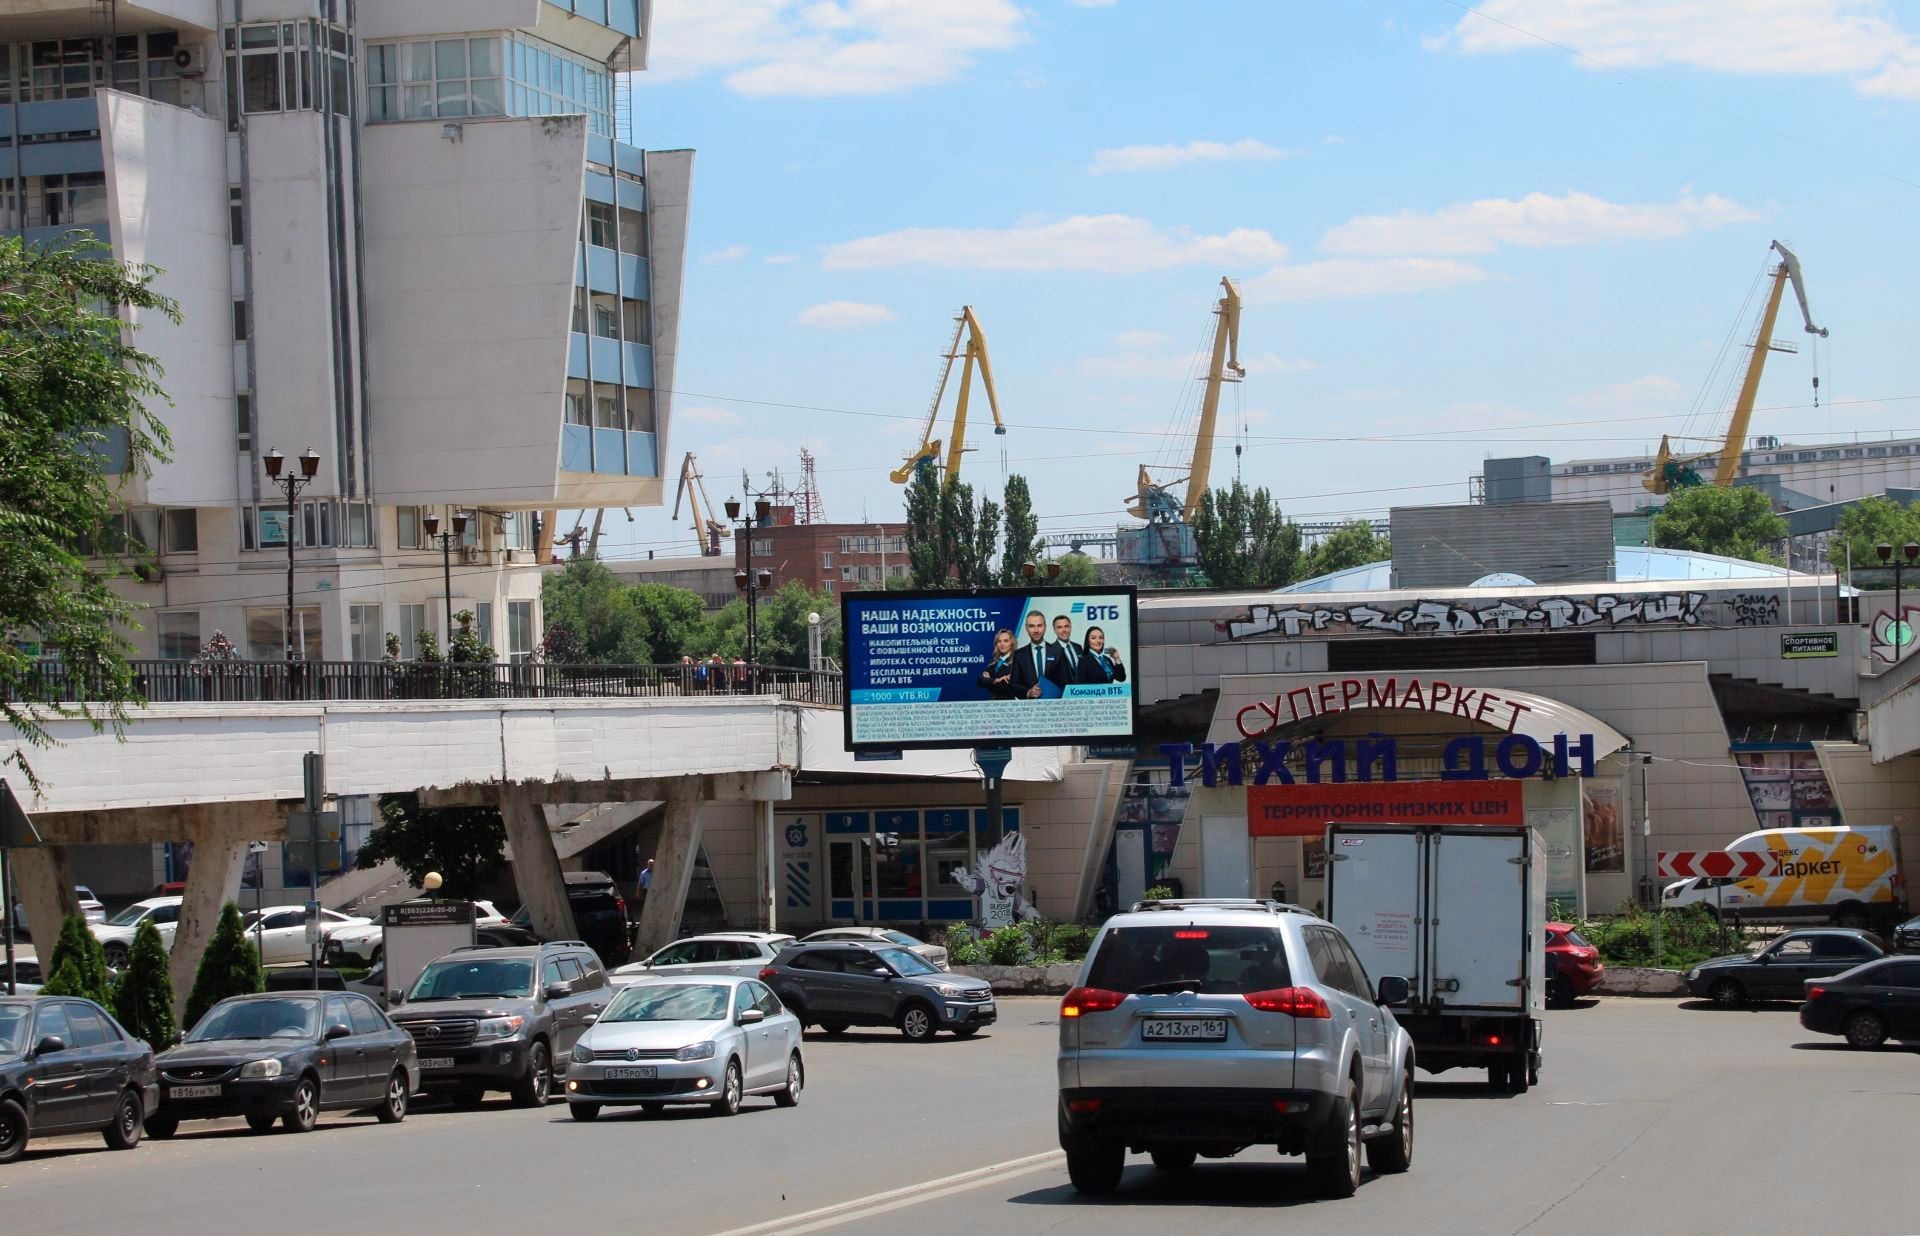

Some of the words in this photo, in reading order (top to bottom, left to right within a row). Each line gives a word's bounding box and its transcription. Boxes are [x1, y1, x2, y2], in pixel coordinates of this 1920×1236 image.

[861, 610, 899, 621] НАША
[902, 608, 987, 621] НАДЕЖНОСТЬ
[1087, 605, 1119, 620] ВТБ
[861, 624, 898, 634] ВАШИ
[901, 621, 995, 634] ВОЗМОЖНОСТИ
[869, 637, 938, 647] НАКОПИТЕЛЬНЫЙ
[1784, 637, 1833, 645] СПОРТИВНОЕ
[877, 645, 933, 655] ПОВЫШЕННОЙ
[935, 644, 970, 654] СТАВКОЙ
[870, 658, 906, 666] ИПОТЕКА
[915, 654, 985, 665] ГОСПОДДЕРЖКОЙ
[870, 668, 920, 677] БЕСПЛАТНАЯ
[922, 667, 968, 676] ДЕБЕТОВАЯ
[870, 677, 897, 685] КАРТА
[898, 676, 912, 684] ВТБ
[871, 692, 892, 701] 1000
[899, 691, 929, 700] VTB.RU
[1070, 688, 1106, 697] Команда
[1108, 687, 1123, 695] ВТБ
[1235, 678, 1531, 738] СУПЕРМАРКЕТ
[1159, 732, 1397, 788] ТИХИЙ
[1441, 732, 1595, 781] ДОН
[1263, 803, 1384, 819] ТЕРРИТОРИЯ
[1389, 801, 1465, 818] НИЗКИХ
[1470, 800, 1508, 818] ЦЕН
[989, 902, 1012, 910] RUSSIA
[991, 909, 1011, 919] 2018
